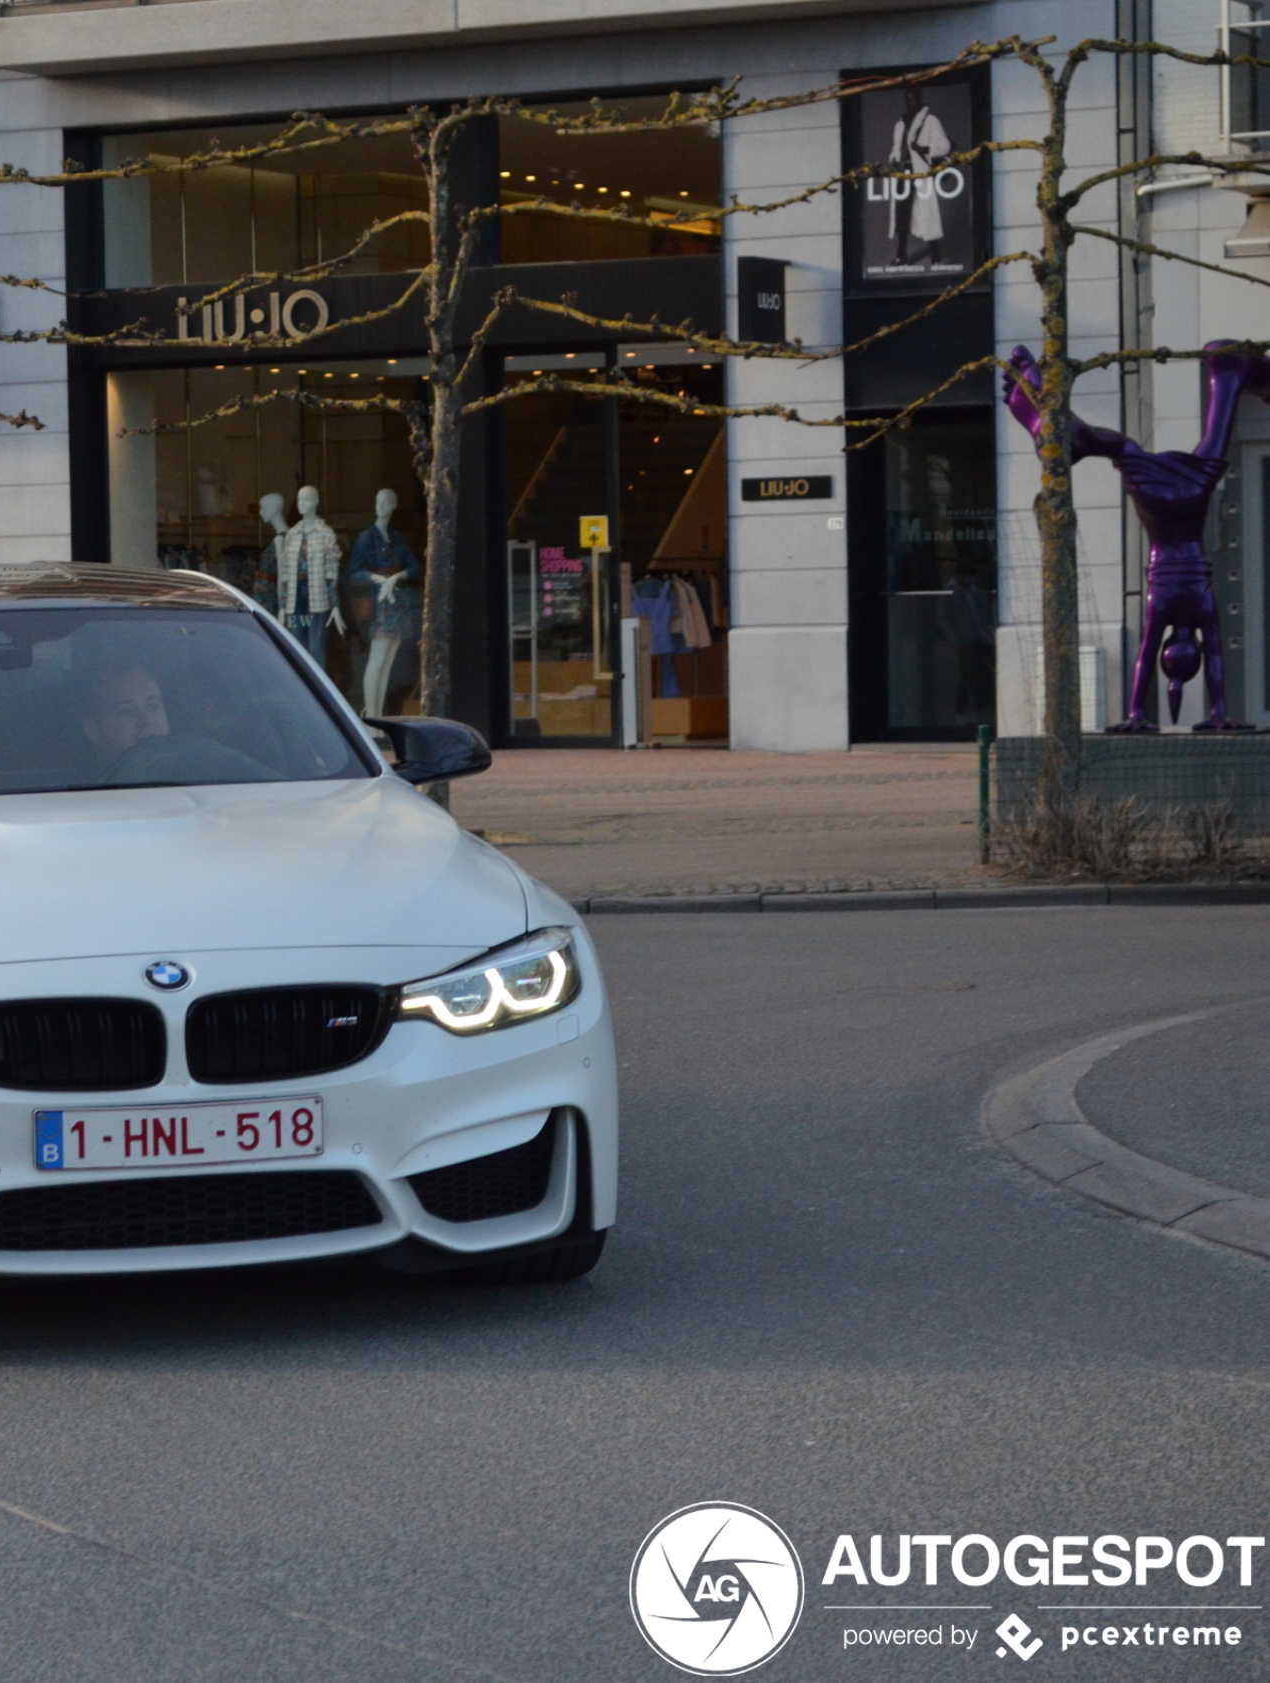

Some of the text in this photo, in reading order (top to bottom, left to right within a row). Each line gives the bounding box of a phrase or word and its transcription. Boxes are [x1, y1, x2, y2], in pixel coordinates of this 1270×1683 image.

[540, 546, 565, 560] HOME
[540, 559, 583, 573] SHOPPING
[42, 1143, 60, 1163] B
